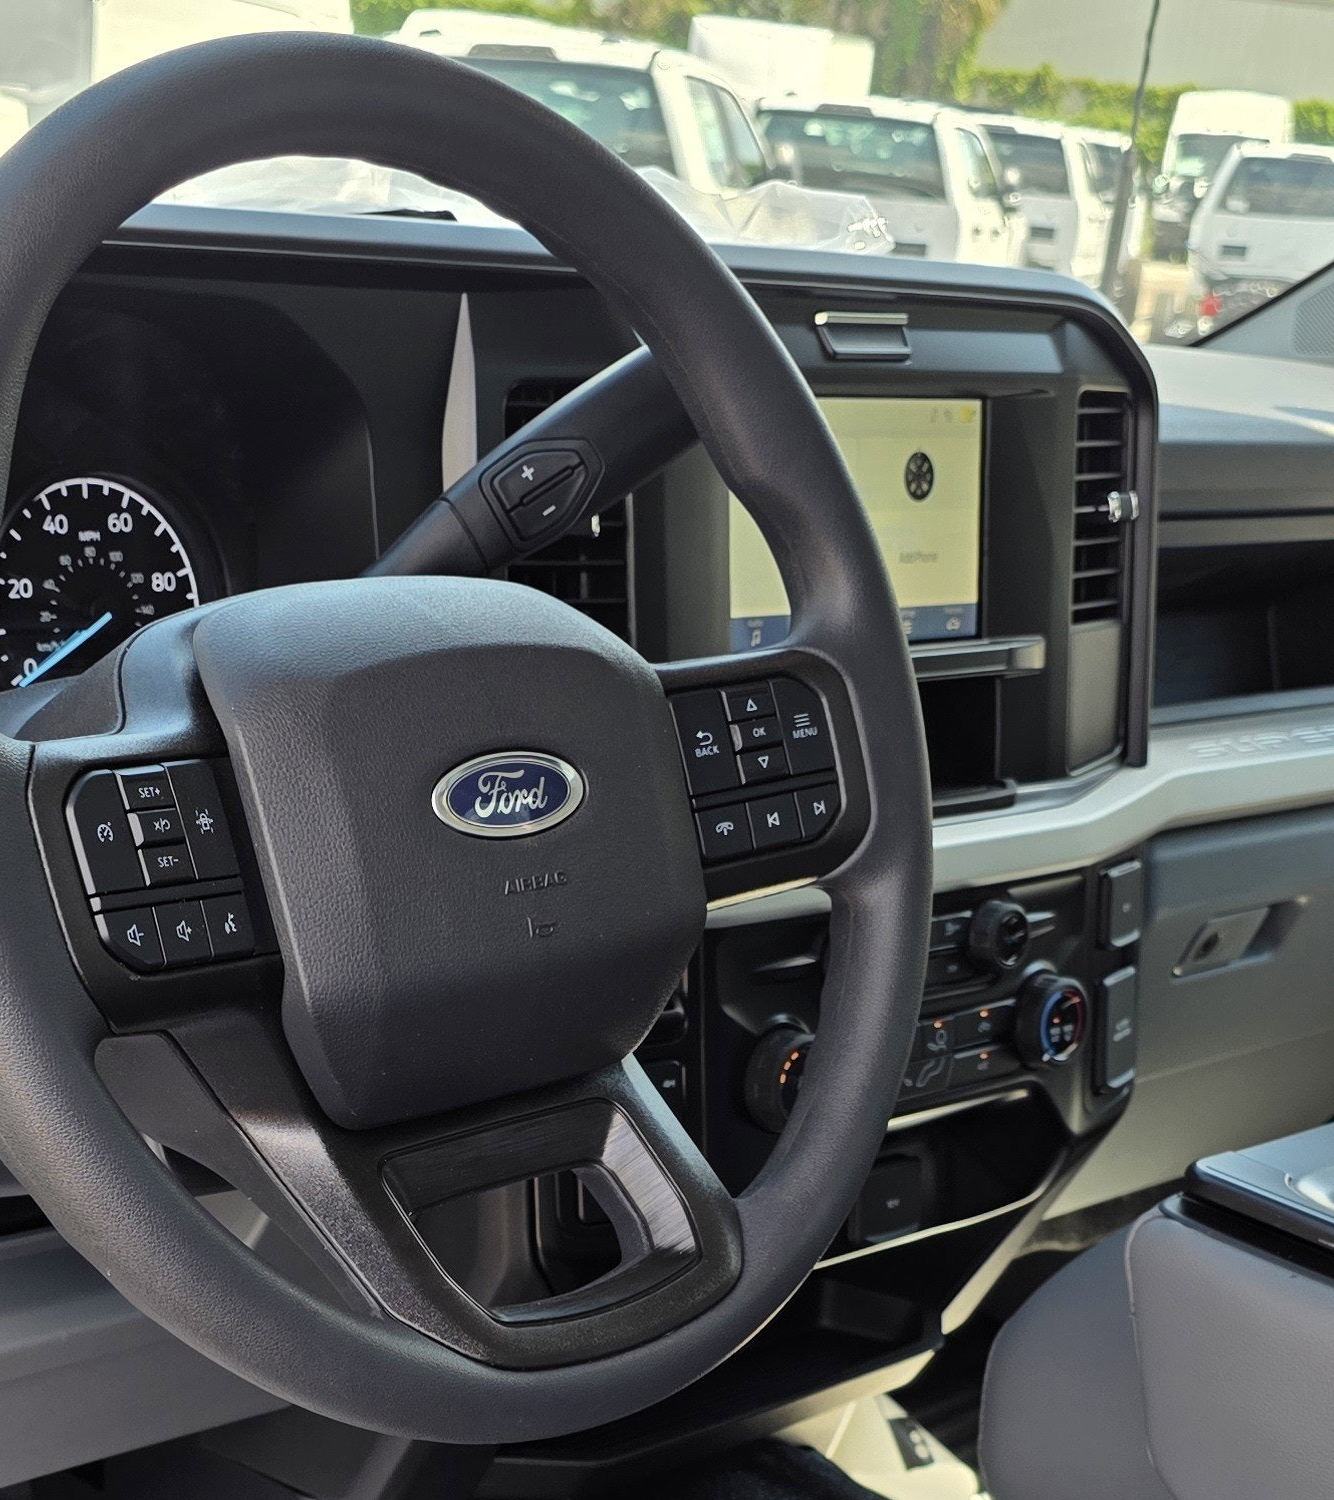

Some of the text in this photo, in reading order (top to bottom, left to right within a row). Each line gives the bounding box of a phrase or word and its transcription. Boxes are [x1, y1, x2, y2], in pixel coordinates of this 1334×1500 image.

[42, 513, 68, 535] 40
[108, 512, 133, 533] 60
[7, 578, 33, 599] 20
[151, 571, 176, 592] 80
[752, 725, 767, 738] OK
[792, 725, 819, 740] MENU
[694, 743, 720, 758] BACK
[474, 770, 548, 818] Ford
[504, 869, 568, 895] AIRBAG
